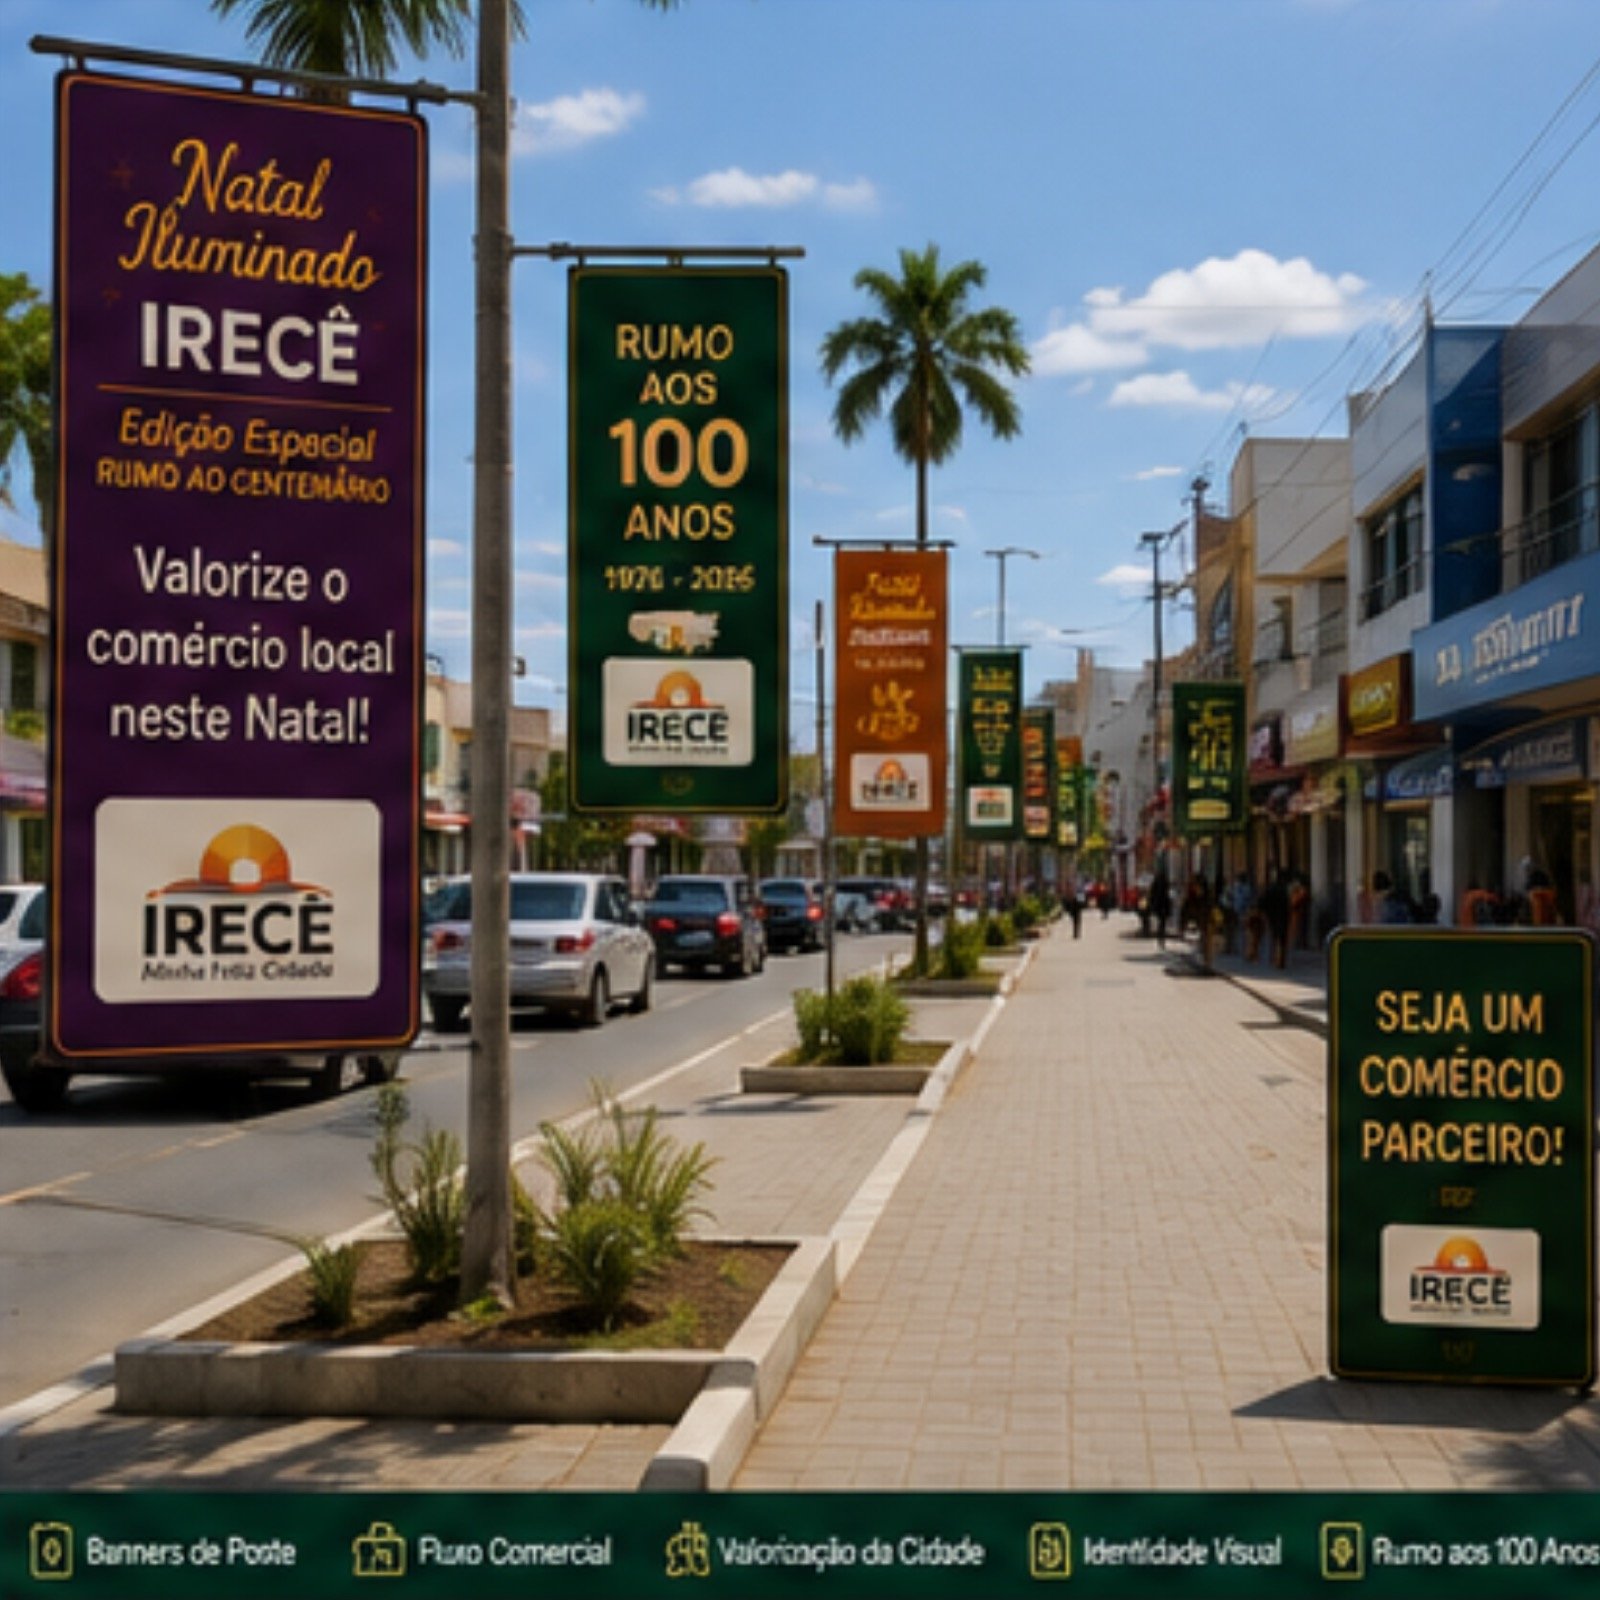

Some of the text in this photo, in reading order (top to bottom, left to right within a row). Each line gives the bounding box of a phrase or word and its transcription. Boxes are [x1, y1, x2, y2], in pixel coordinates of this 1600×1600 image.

[172, 139, 331, 219] Natal
[120, 202, 380, 291] Iluminado
[143, 302, 359, 384] IRECÊ
[617, 324, 733, 360] RUMO
[640, 371, 716, 405] AOS
[120, 408, 376, 464] Edição Especial
[610, 418, 748, 487] 100
[98, 455, 183, 489] RUMO
[186, 465, 225, 492] AO
[625, 503, 734, 540] ANOS
[134, 546, 347, 602] Valorize o
[88, 622, 393, 673] comércio local
[111, 694, 369, 743] neste Natal!
[144, 896, 333, 956] IRECÊ
[1377, 991, 1542, 1033] SEJA UM
[1360, 1046, 1563, 1100] COMÉRCIO
[1363, 1120, 1563, 1165] PARCEIRO!
